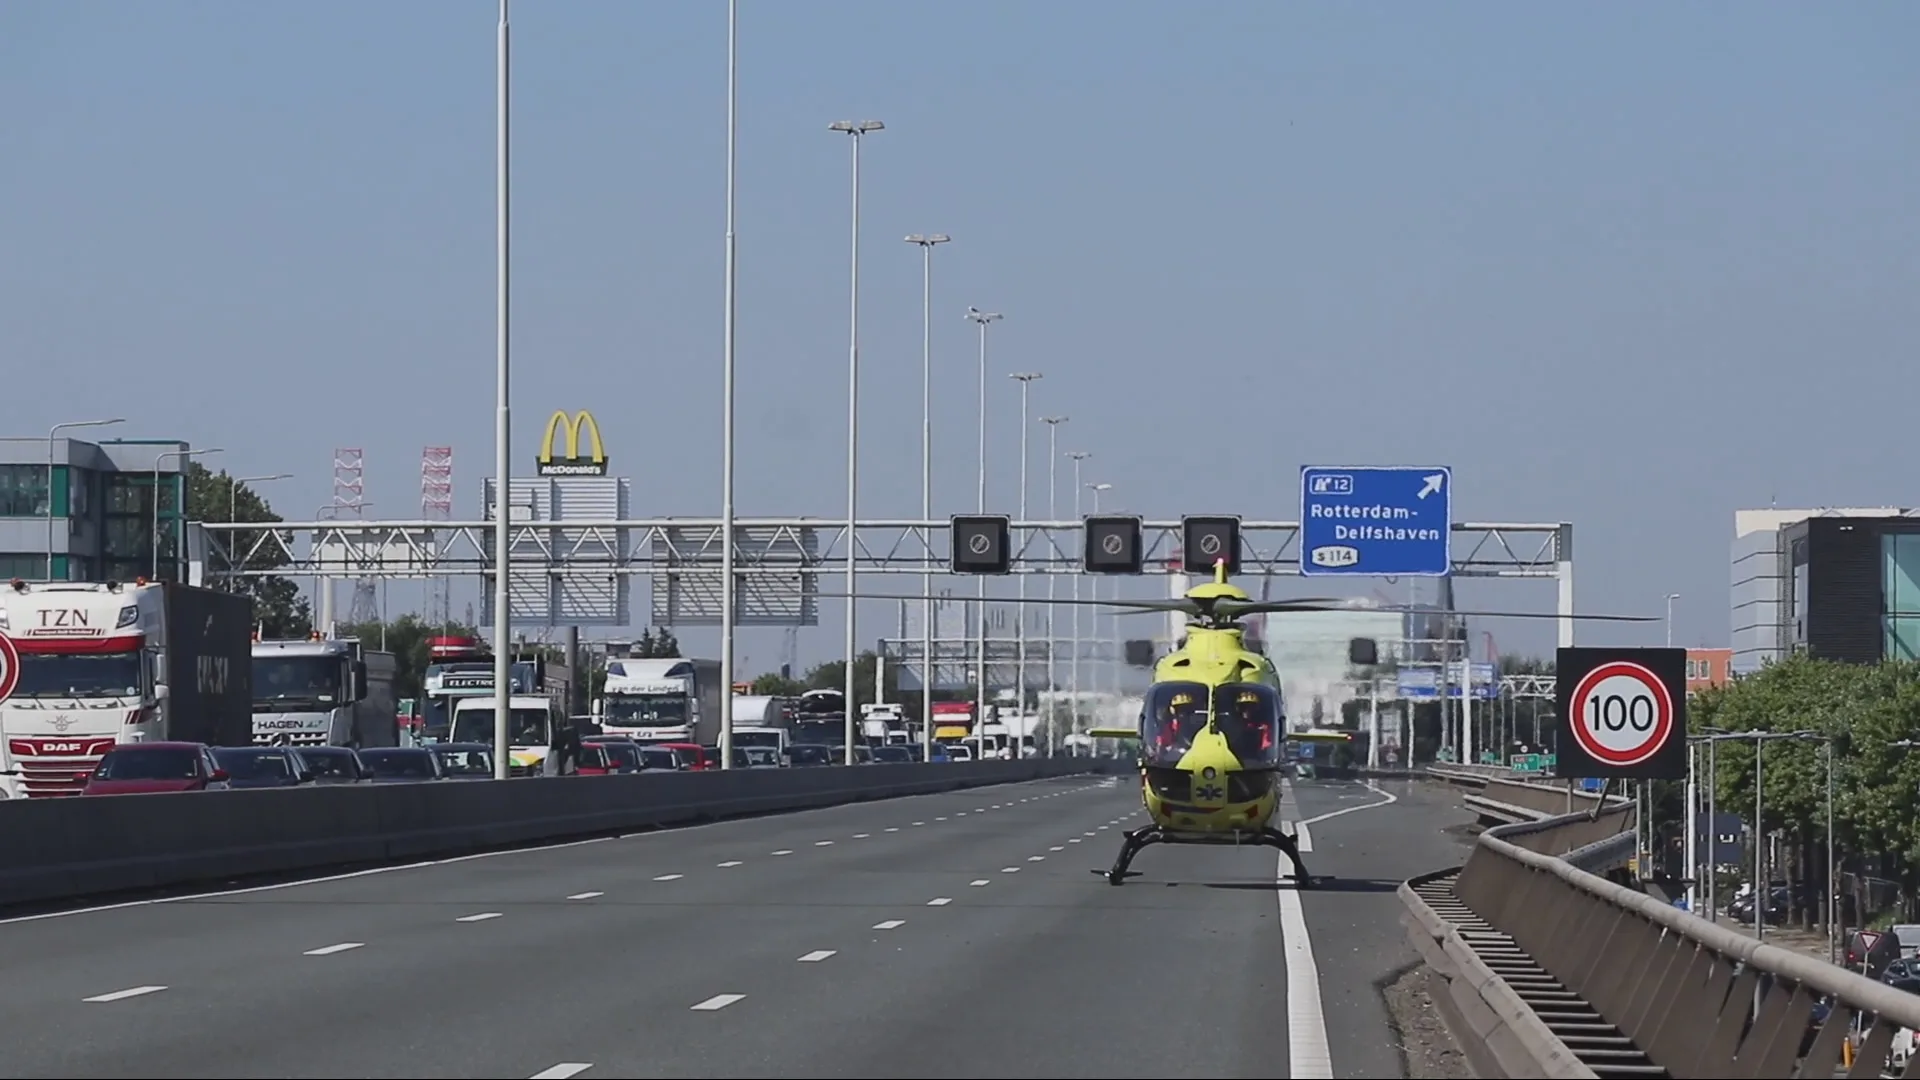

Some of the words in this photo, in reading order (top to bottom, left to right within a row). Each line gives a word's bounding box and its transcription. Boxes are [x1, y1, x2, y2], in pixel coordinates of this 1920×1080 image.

[541, 465, 601, 474] McDonald's
[1334, 479, 1349, 490] 12
[1311, 504, 1418, 519] Rotterdam-
[1335, 525, 1440, 541] Delfshaven
[1330, 550, 1353, 562] 114
[37, 609, 89, 626] TZN
[1590, 694, 1653, 731] 100
[258, 720, 303, 729] HAGEN
[43, 743, 81, 751] DAF
